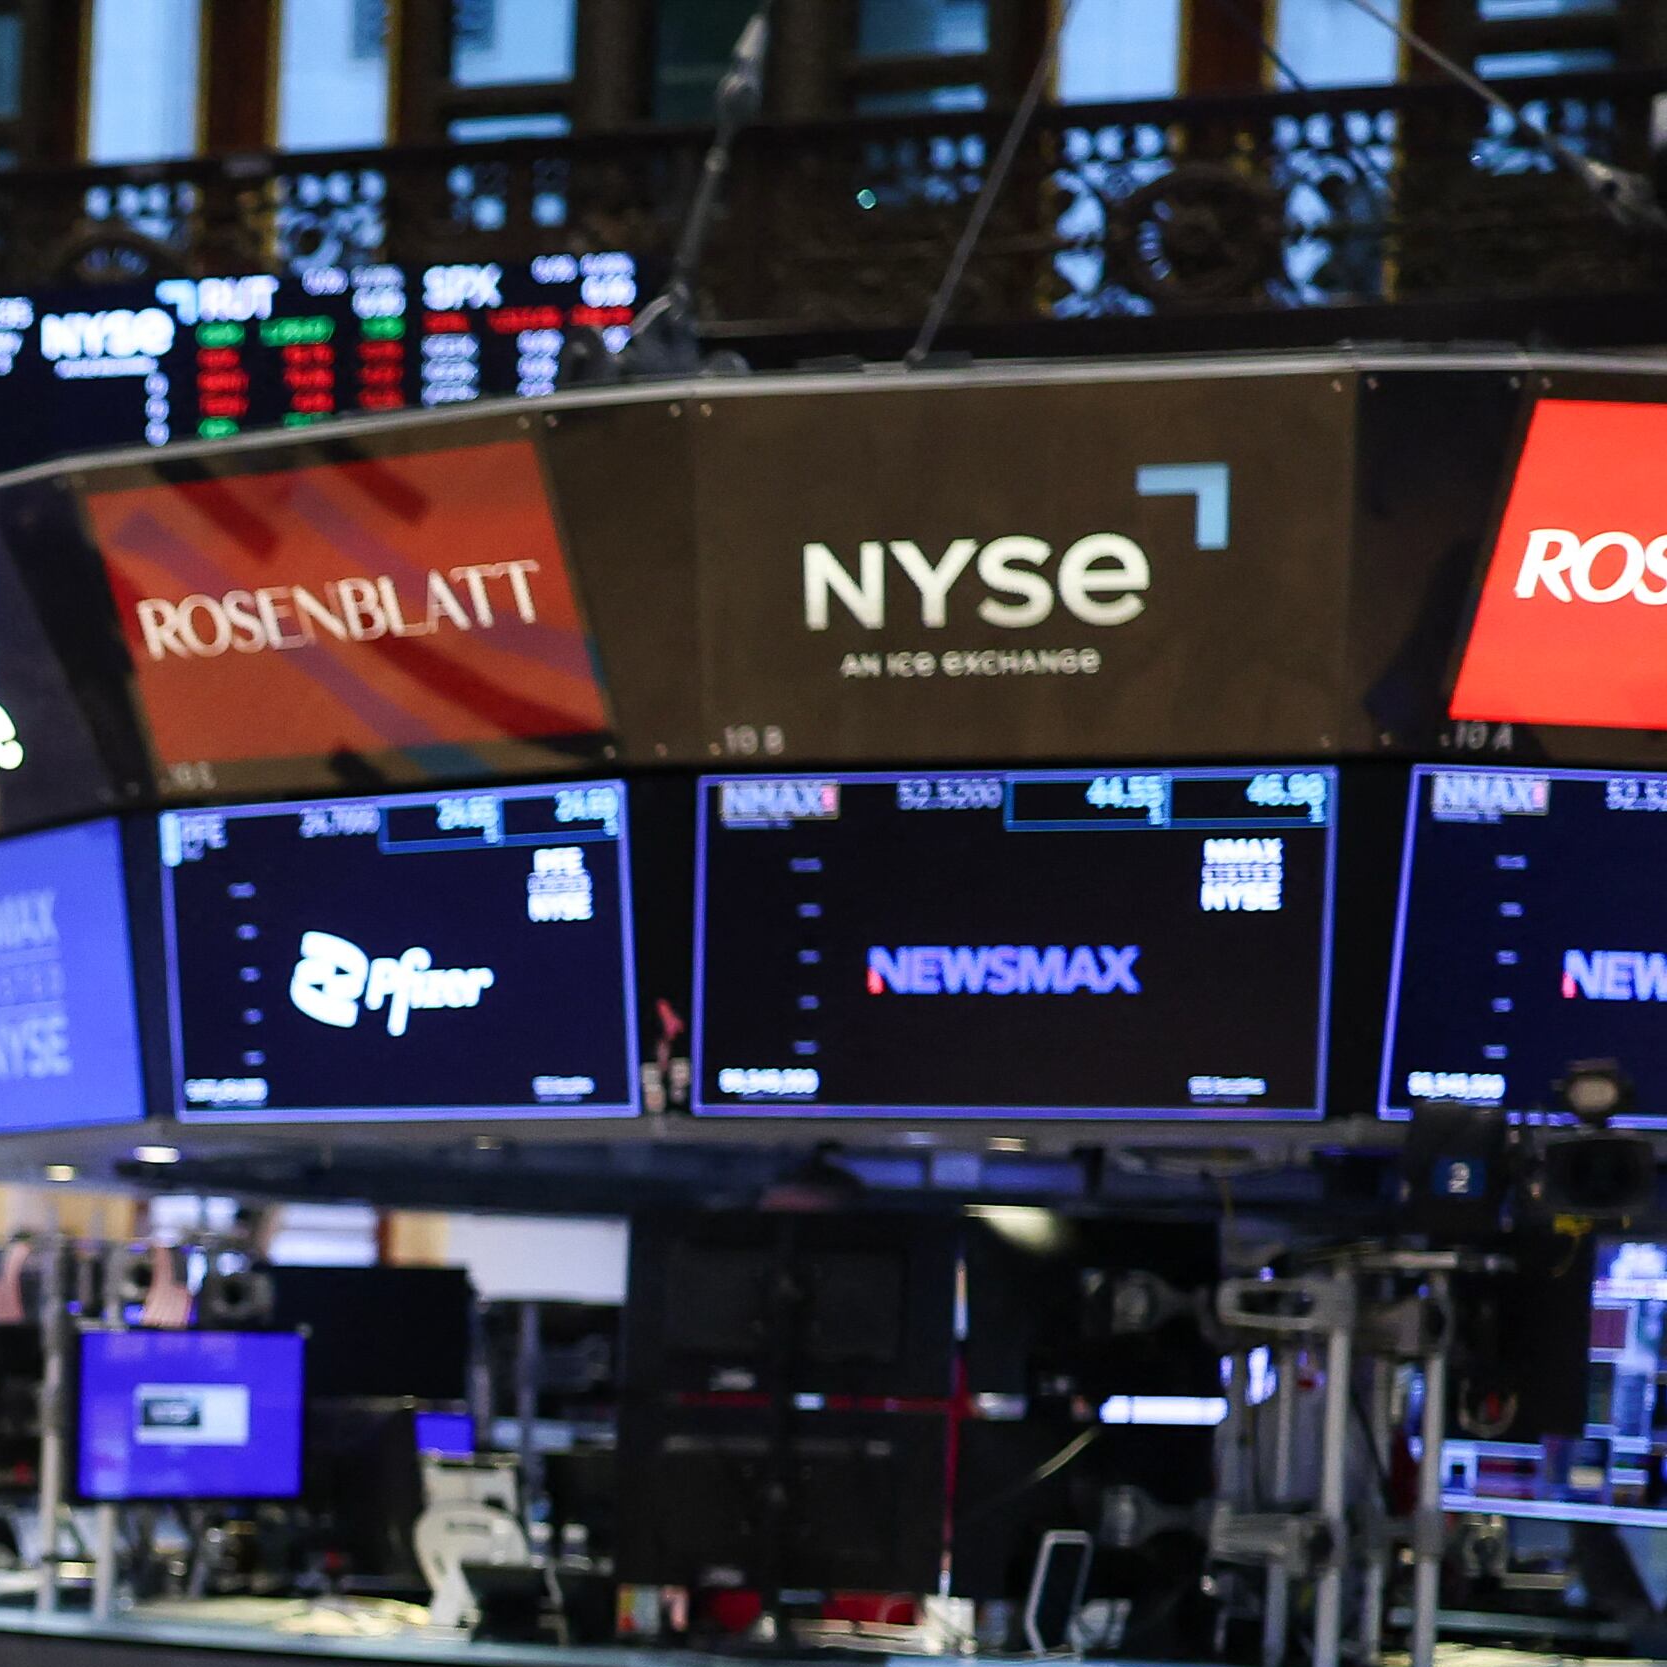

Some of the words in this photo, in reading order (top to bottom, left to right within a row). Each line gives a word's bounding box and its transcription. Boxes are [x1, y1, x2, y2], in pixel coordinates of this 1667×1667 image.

[136, 559, 541, 661] ROSENBLATT
[1085, 774, 1165, 808] 44.55
[867, 945, 1143, 996] NEWSMAX
